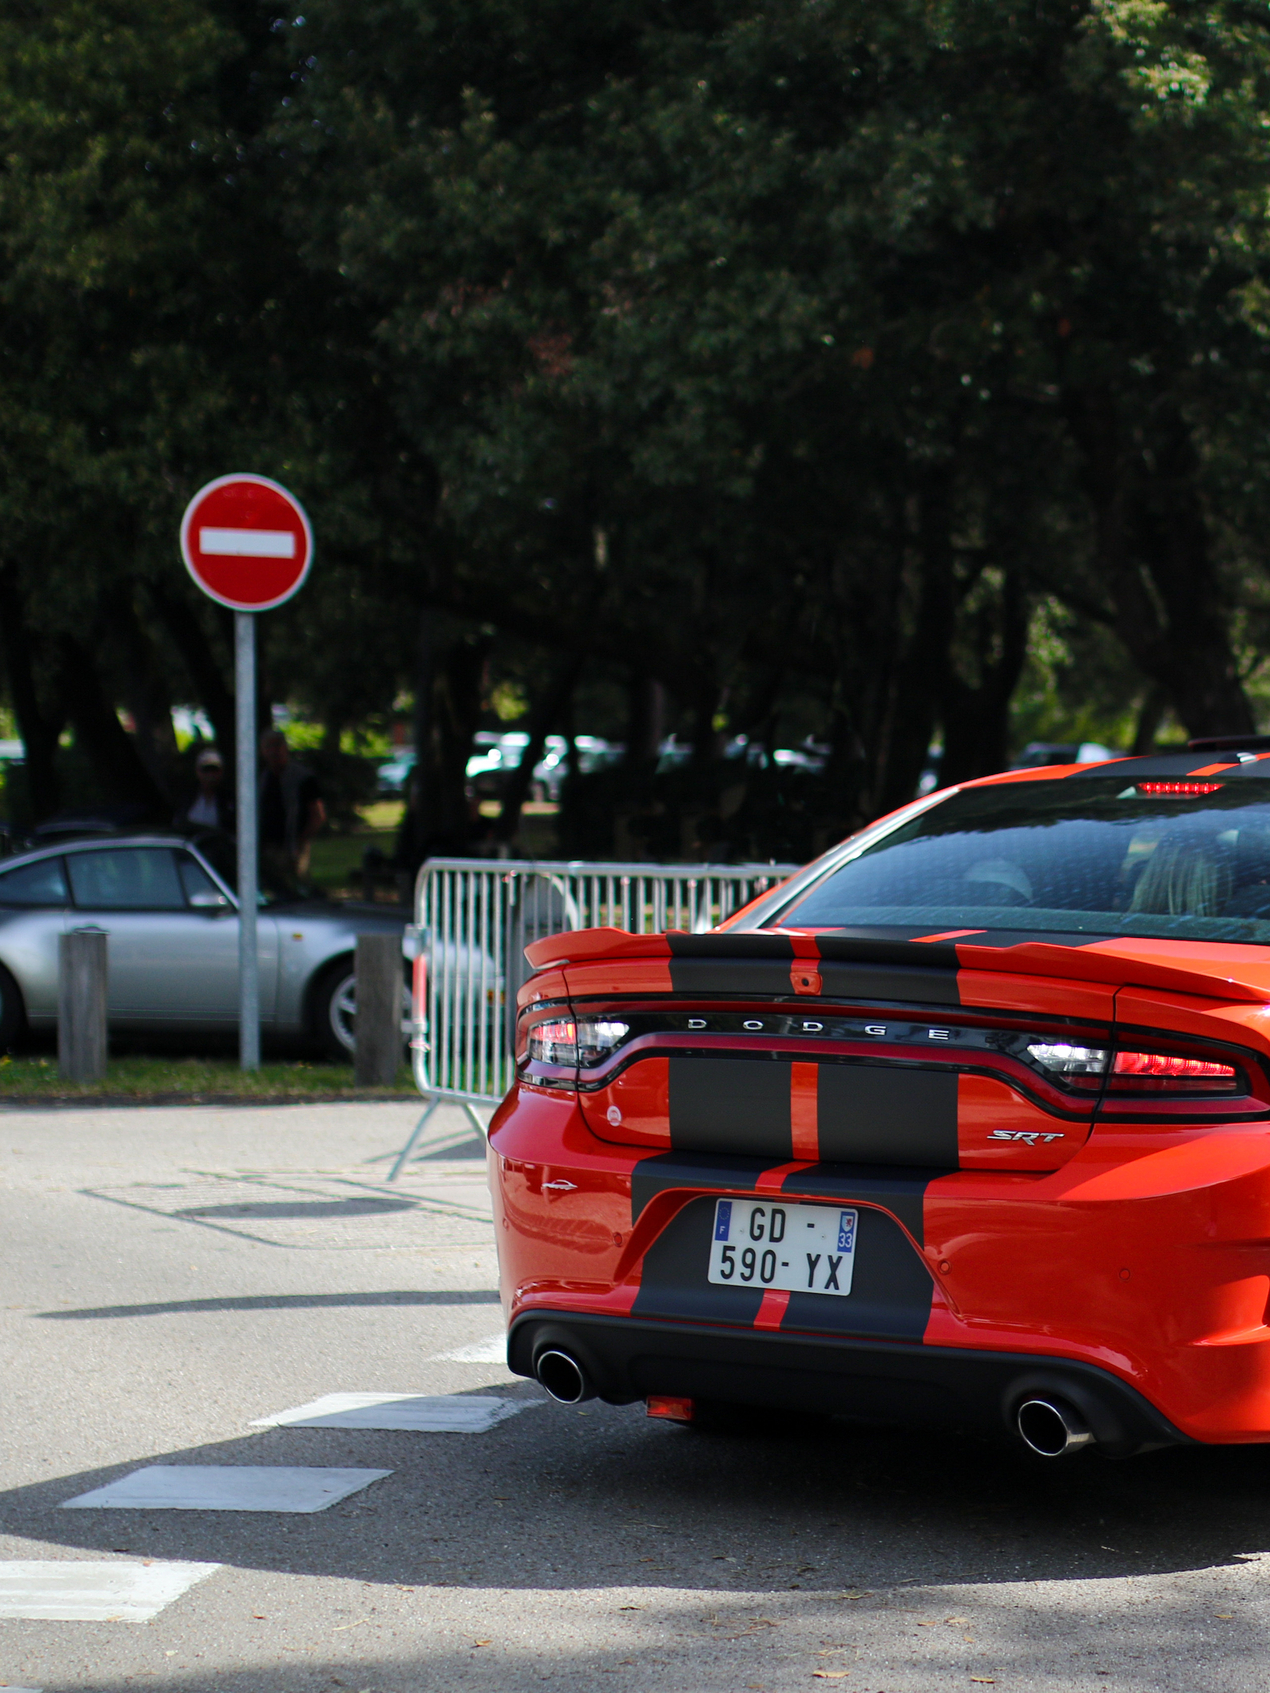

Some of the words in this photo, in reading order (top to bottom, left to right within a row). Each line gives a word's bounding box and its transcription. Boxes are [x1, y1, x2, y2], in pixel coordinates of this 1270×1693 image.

[688, 1018, 950, 1040] DODGE
[986, 1129, 1065, 1146] SRT
[718, 1225, 726, 1235] F
[838, 1232, 852, 1248] 33
[806, 1252, 843, 1291] YX
